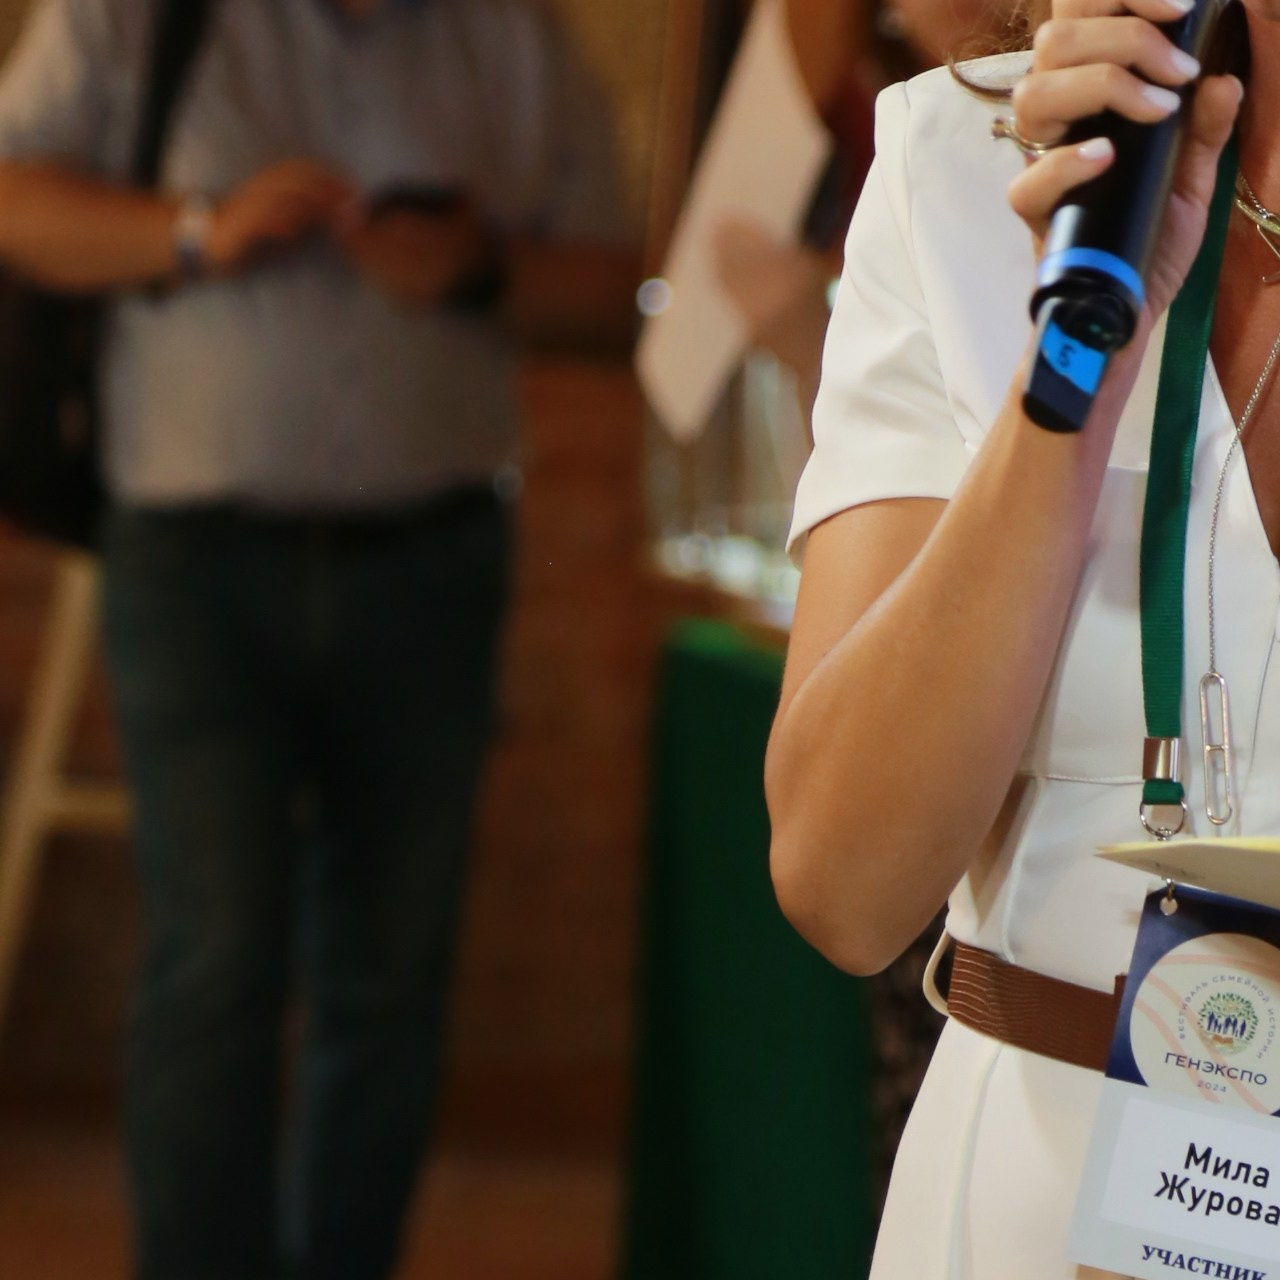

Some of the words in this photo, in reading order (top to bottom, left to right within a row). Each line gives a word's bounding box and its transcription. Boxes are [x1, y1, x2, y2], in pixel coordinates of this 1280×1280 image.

[1212, 975, 1270, 1003] СЕМЕЙНОЙ
[1256, 1008, 1276, 1060] ИСТОРИИ
[1164, 1052, 1268, 1086] ГЕНЭКСПО
[1197, 1080, 1227, 1093] 2024
[1184, 1142, 1270, 1189] Мила
